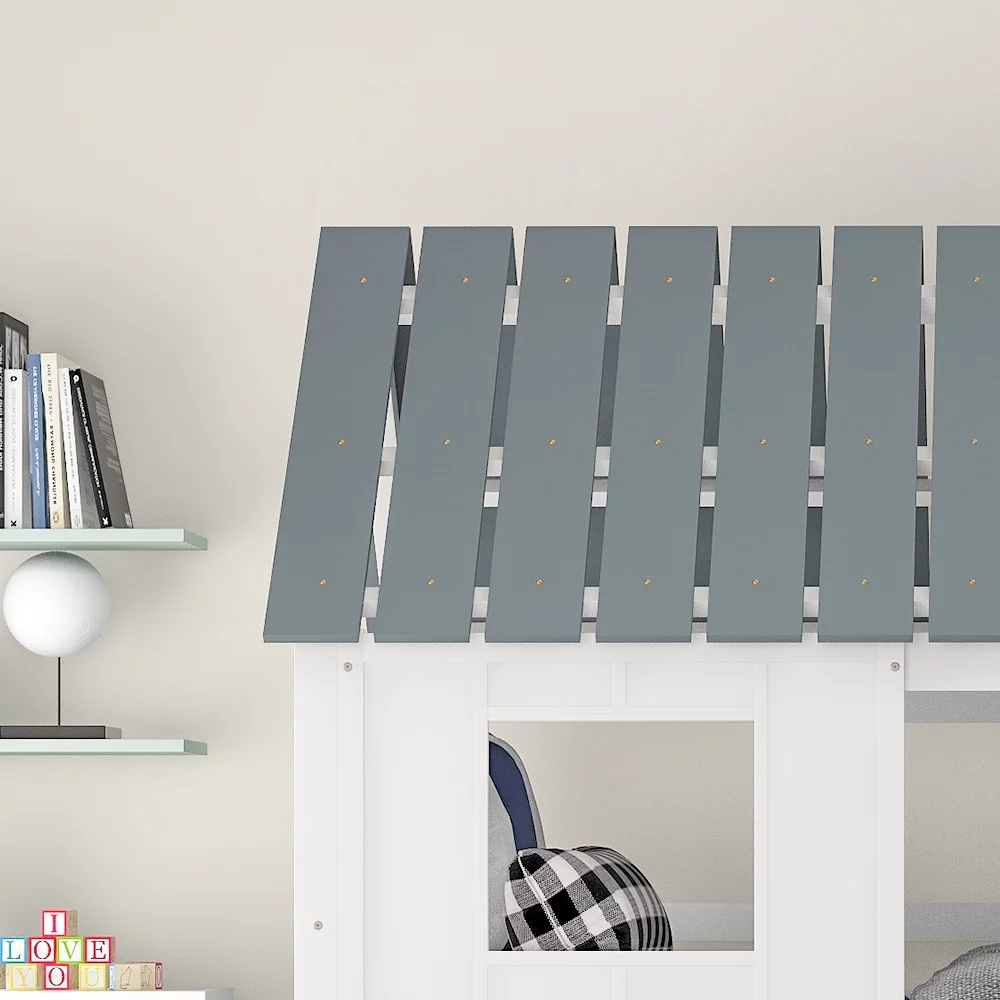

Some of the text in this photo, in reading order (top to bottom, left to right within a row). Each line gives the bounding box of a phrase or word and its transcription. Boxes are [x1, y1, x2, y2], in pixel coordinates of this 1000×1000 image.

[51, 914, 59, 933] I
[6, 940, 106, 960] LOVE
[16, 967, 101, 987] YOU
